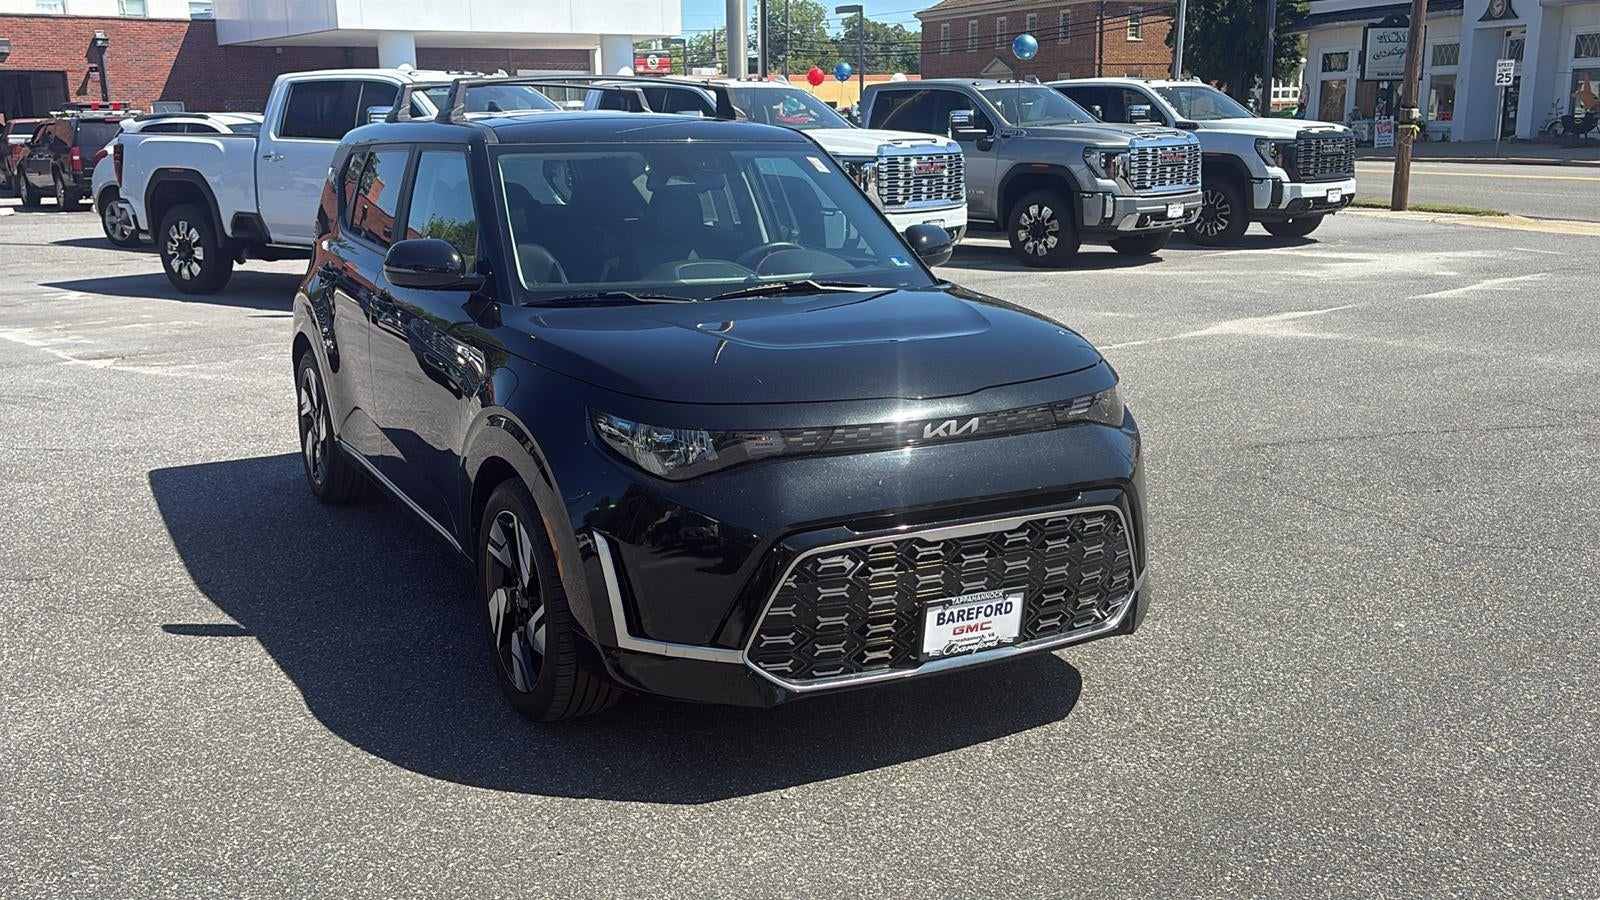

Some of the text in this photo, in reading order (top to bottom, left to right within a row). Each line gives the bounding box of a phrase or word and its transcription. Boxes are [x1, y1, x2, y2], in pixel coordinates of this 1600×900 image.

[1496, 73, 1512, 84] 25
[923, 417, 979, 439] KIA
[951, 590, 1004, 606] TAPPAHANNOCK
[936, 601, 1013, 626] BAREFORD
[952, 620, 992, 636] GMC
[943, 636, 999, 655] Bareford
